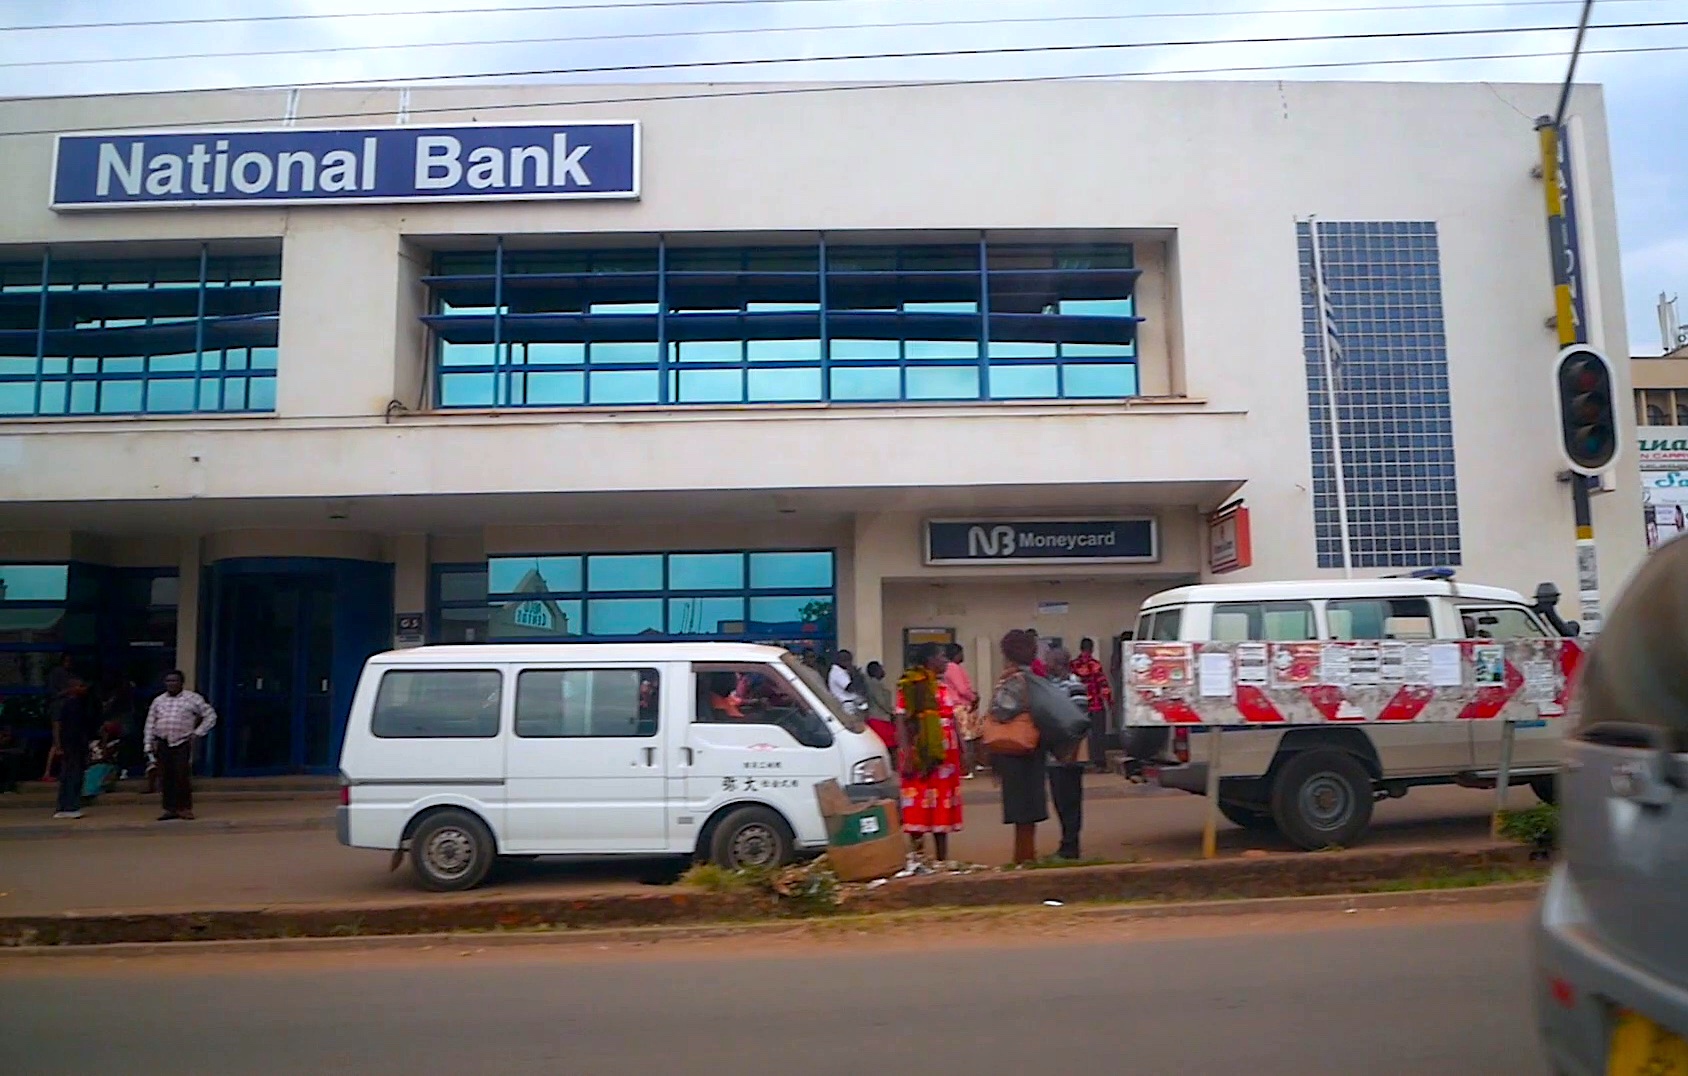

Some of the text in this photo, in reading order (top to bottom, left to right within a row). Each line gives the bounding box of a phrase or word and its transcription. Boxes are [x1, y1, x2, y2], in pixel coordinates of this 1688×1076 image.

[95, 132, 593, 198] National Bank
[1019, 532, 1115, 549] Moneycard
